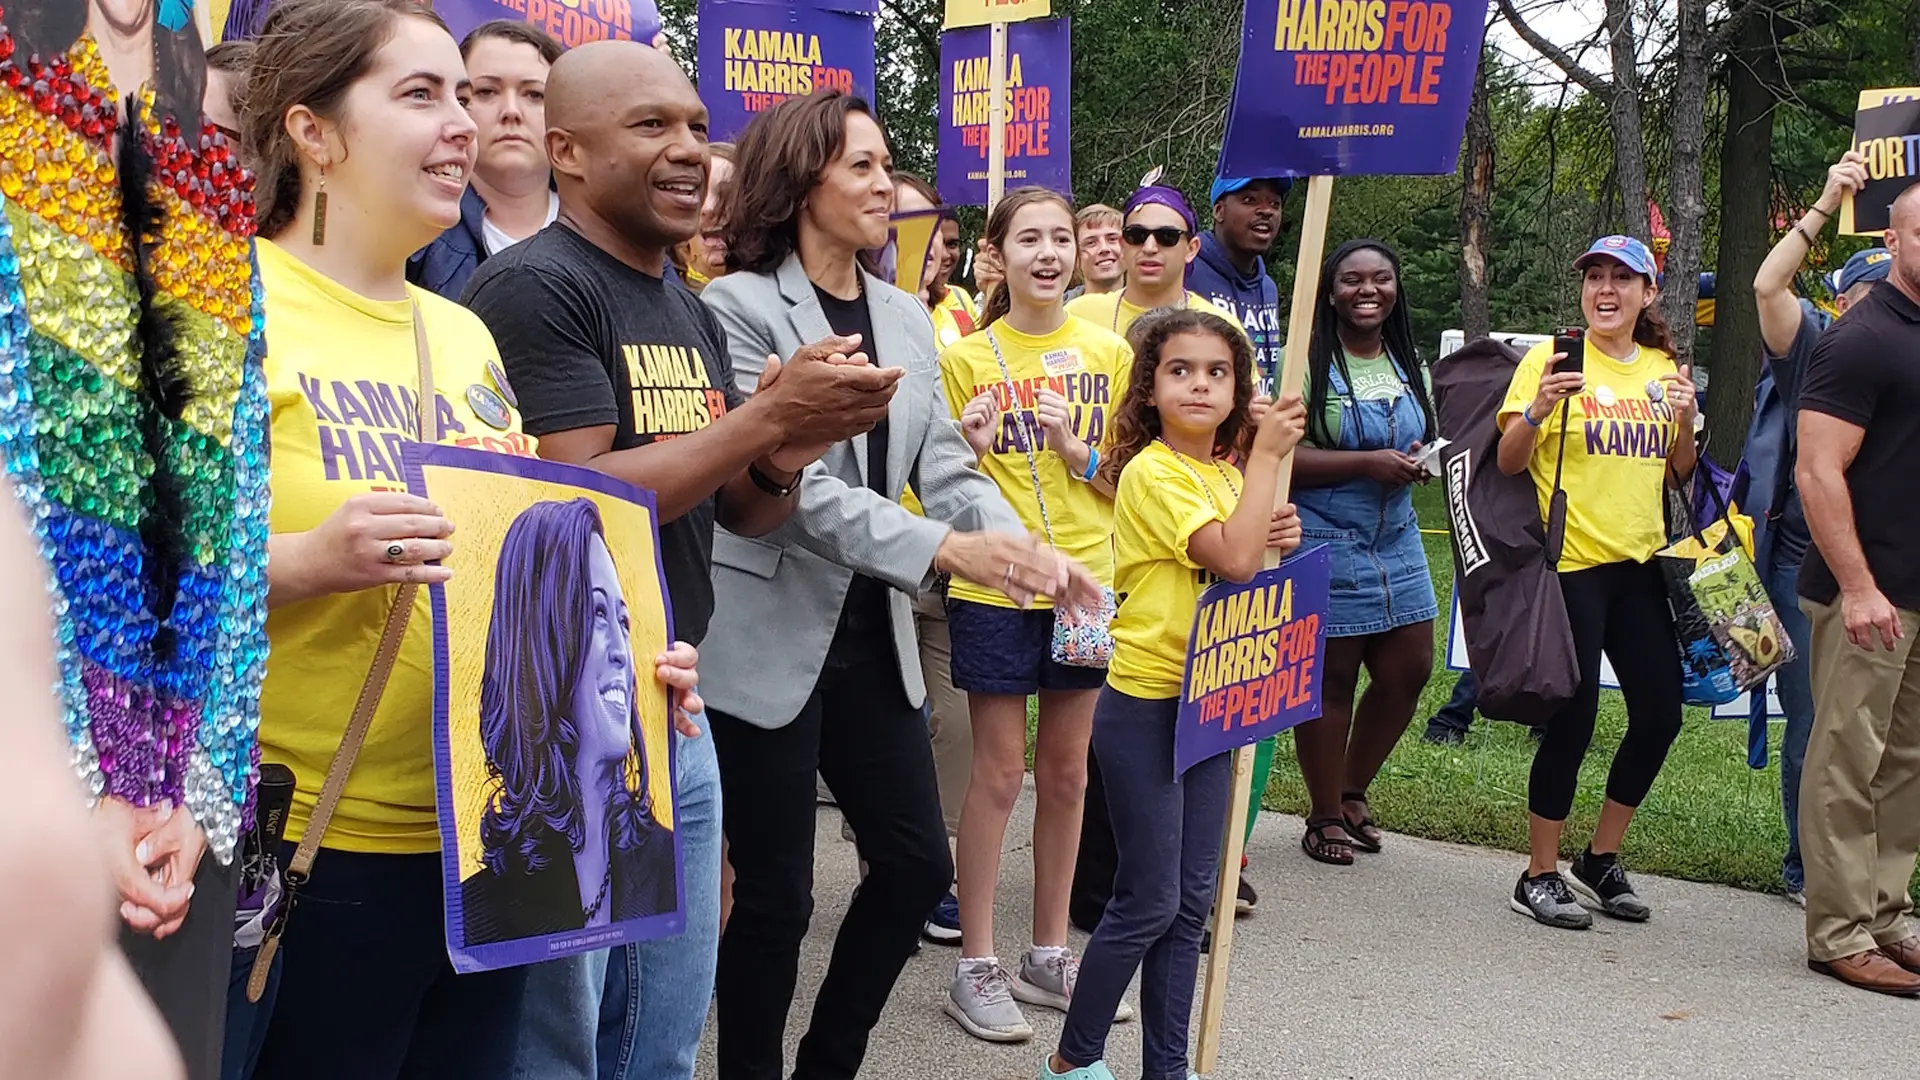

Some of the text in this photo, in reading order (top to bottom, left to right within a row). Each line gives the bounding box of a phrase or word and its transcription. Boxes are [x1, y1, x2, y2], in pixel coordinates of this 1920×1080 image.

[526, 0, 631, 48] PEOPL
[1274, 0, 1452, 53] HARRIS FOR
[724, 28, 823, 66] KAMALA
[724, 60, 853, 97] HARRIS FOR
[953, 53, 1023, 93] KAMA
[1294, 53, 1444, 105] THE PEOPLE
[952, 86, 1050, 127] HARRS FOR
[962, 122, 1050, 159] THE POPLE
[1298, 124, 1394, 139] KAMALAHARRIS.ORG
[1859, 136, 1906, 181] FOR
[621, 344, 712, 389] KAMALA
[1065, 372, 1110, 405] FOR
[297, 371, 466, 442] KAMAA
[631, 388, 711, 435] HARRIS
[1650, 399, 1673, 422] FO
[992, 405, 1104, 455] AMLA
[1584, 420, 1668, 459] KAMAL
[1451, 461, 1479, 564] CRAFTSMAN
[1194, 578, 1293, 655] KAMALA
[1188, 613, 1320, 704] HARRIS FOR
[1199, 659, 1314, 731] THE PEOPLE
